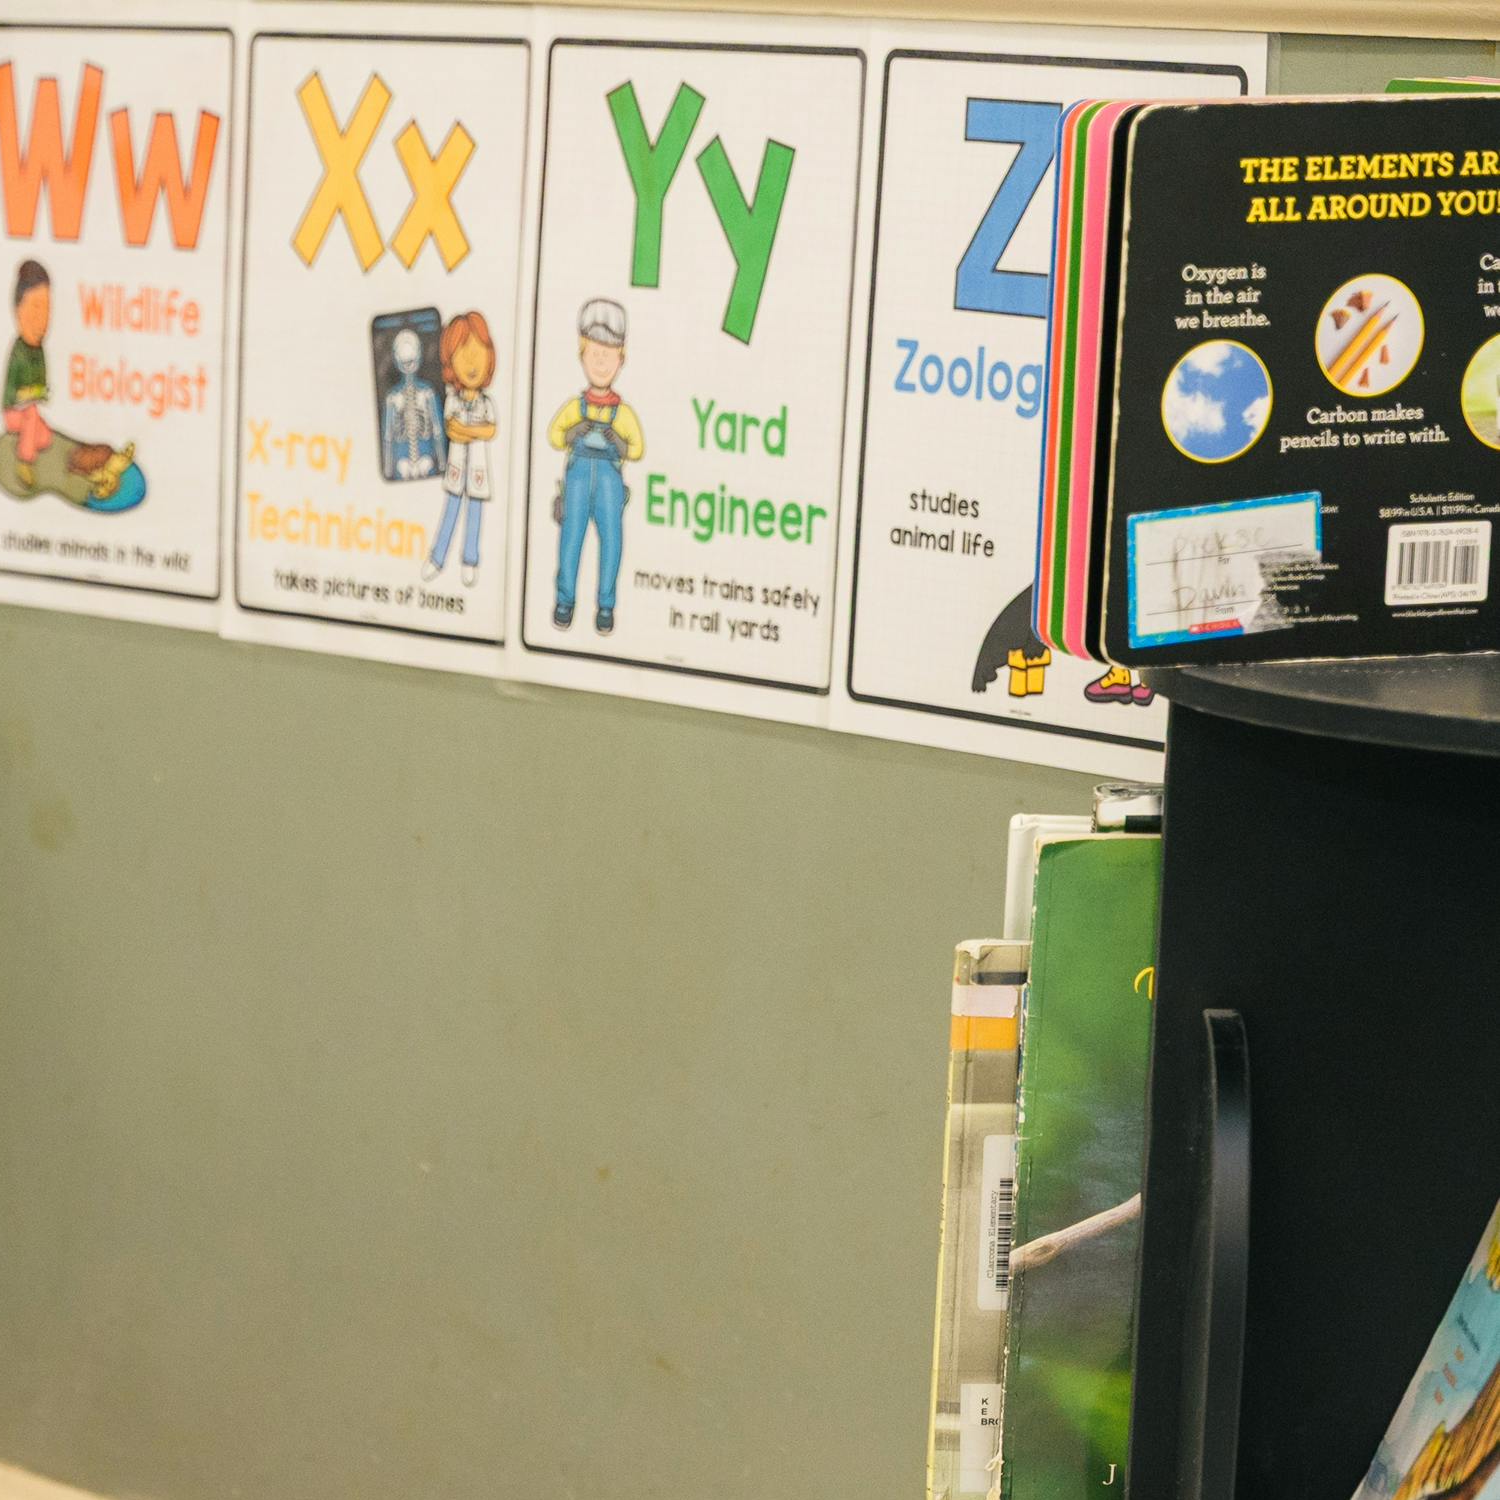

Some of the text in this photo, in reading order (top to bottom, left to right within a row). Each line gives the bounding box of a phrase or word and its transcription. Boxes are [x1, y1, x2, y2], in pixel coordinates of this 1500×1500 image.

[291, 70, 476, 273] Xx
[1239, 150, 1500, 184] THE ELEMENTS AR
[605, 80, 796, 345] Yy
[1246, 196, 1301, 223] ALL
[1306, 192, 1432, 221] AROUND
[1181, 262, 1267, 287] Oxygen is
[1477, 278, 1494, 294] in
[79, 284, 200, 336] Wildlife
[1184, 287, 1262, 306] in the air
[1174, 309, 1271, 330] we breathe.
[68, 354, 208, 420] Biologist
[692, 396, 788, 457] Yard
[1306, 404, 1424, 424] Carbon makes
[247, 418, 353, 486] X-ray
[1280, 426, 1449, 453] pencils to write with.
[644, 474, 827, 545] Engineer
[909, 488, 980, 519] studies
[247, 491, 428, 561] Technician
[890, 524, 995, 558] animal life
[273, 567, 465, 614] takes pictures of bones
[634, 568, 822, 614] moves trains safely
[669, 609, 781, 643] in rail yards
